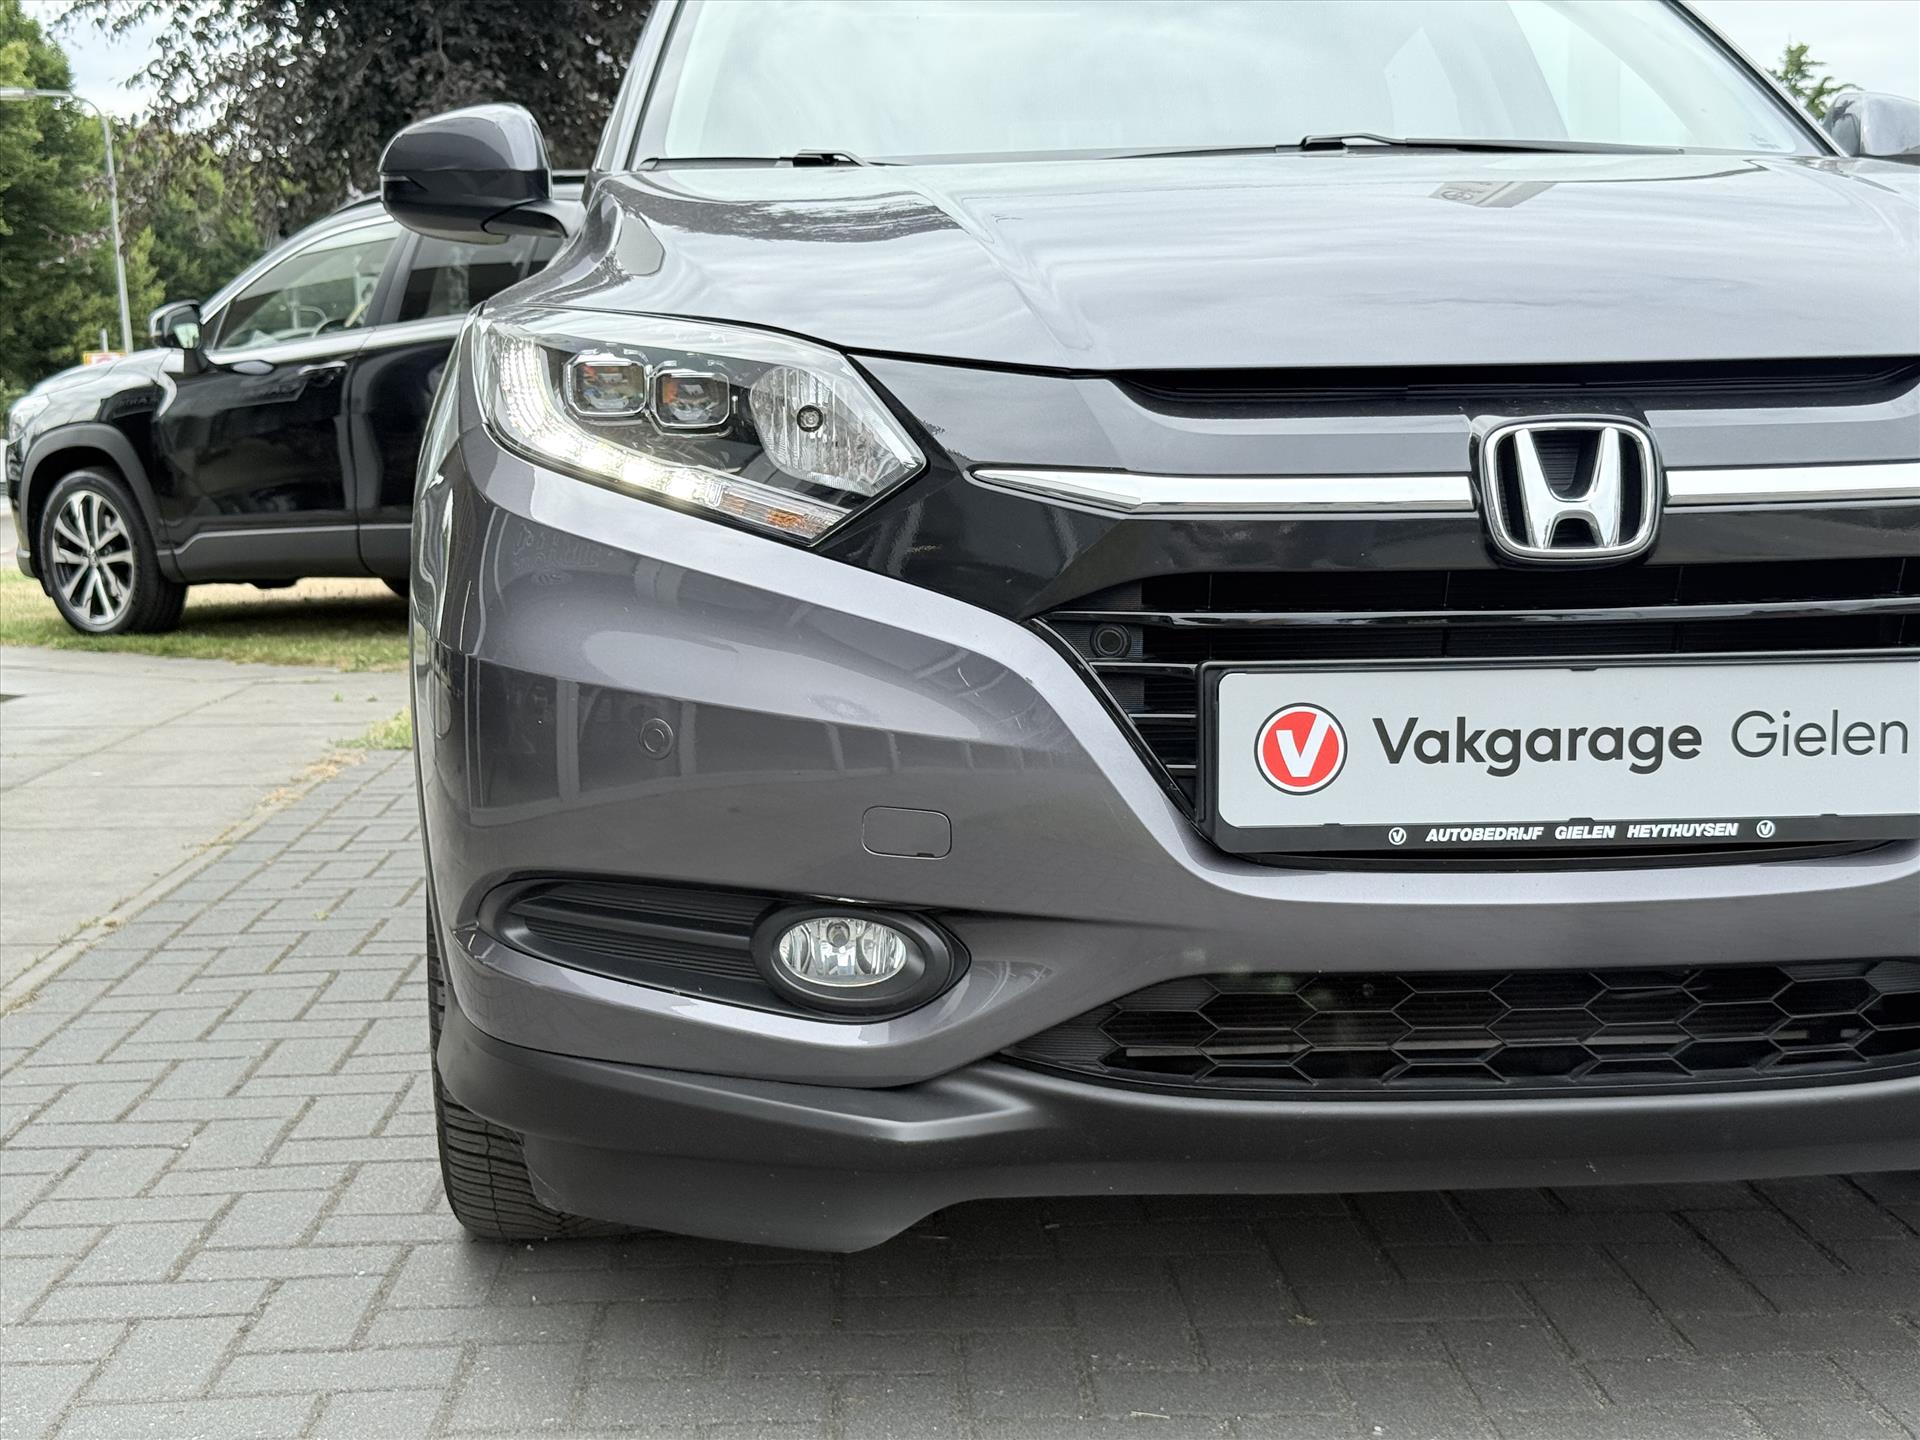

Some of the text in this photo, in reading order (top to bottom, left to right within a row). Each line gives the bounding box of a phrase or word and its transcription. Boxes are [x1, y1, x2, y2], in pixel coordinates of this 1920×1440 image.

[1371, 709, 1909, 777] Vakgarage Gielen
[1425, 826, 1544, 842] AUTOBEDRIJF
[1555, 825, 1616, 840] GIELEN
[1626, 822, 1739, 839] HEYTHUYSEN
